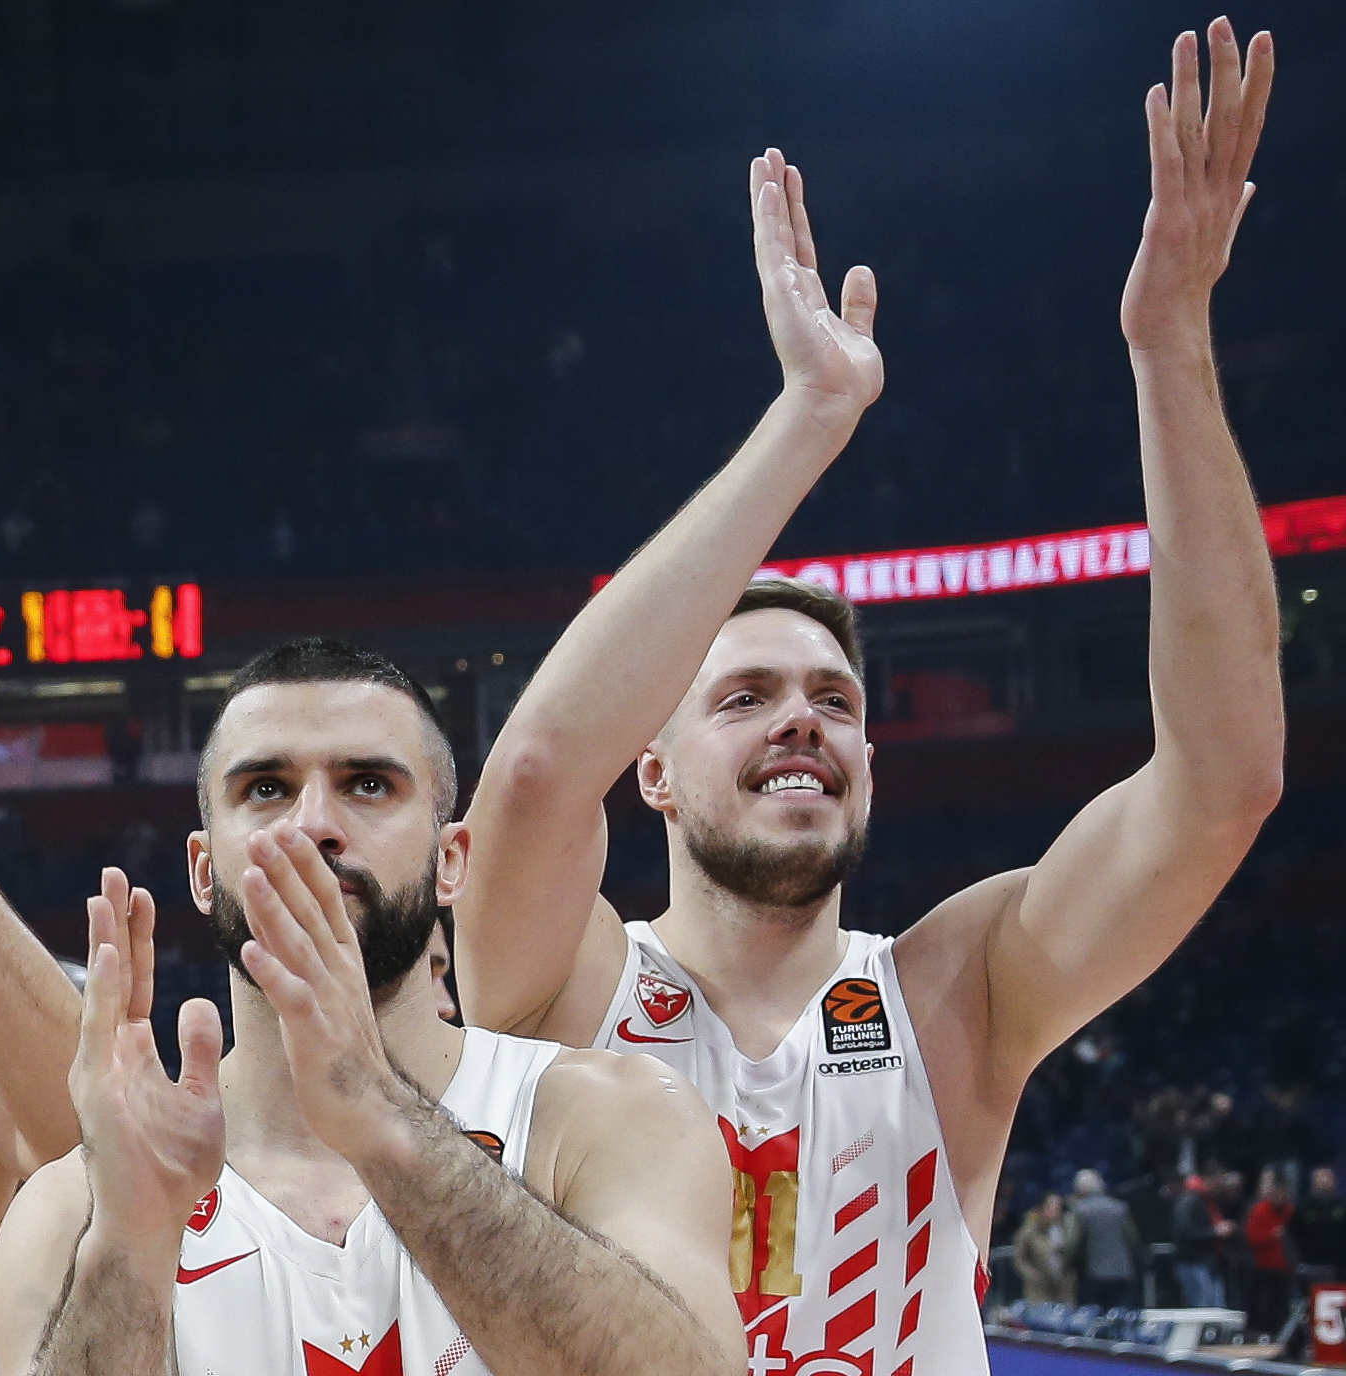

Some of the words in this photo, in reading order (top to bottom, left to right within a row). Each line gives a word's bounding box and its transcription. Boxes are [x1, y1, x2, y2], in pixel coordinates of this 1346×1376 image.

[844, 529, 1150, 600] KKCRVENAZVEZD
[831, 1023, 883, 1034] TURKISH
[833, 1031, 884, 1042] AIRLINES
